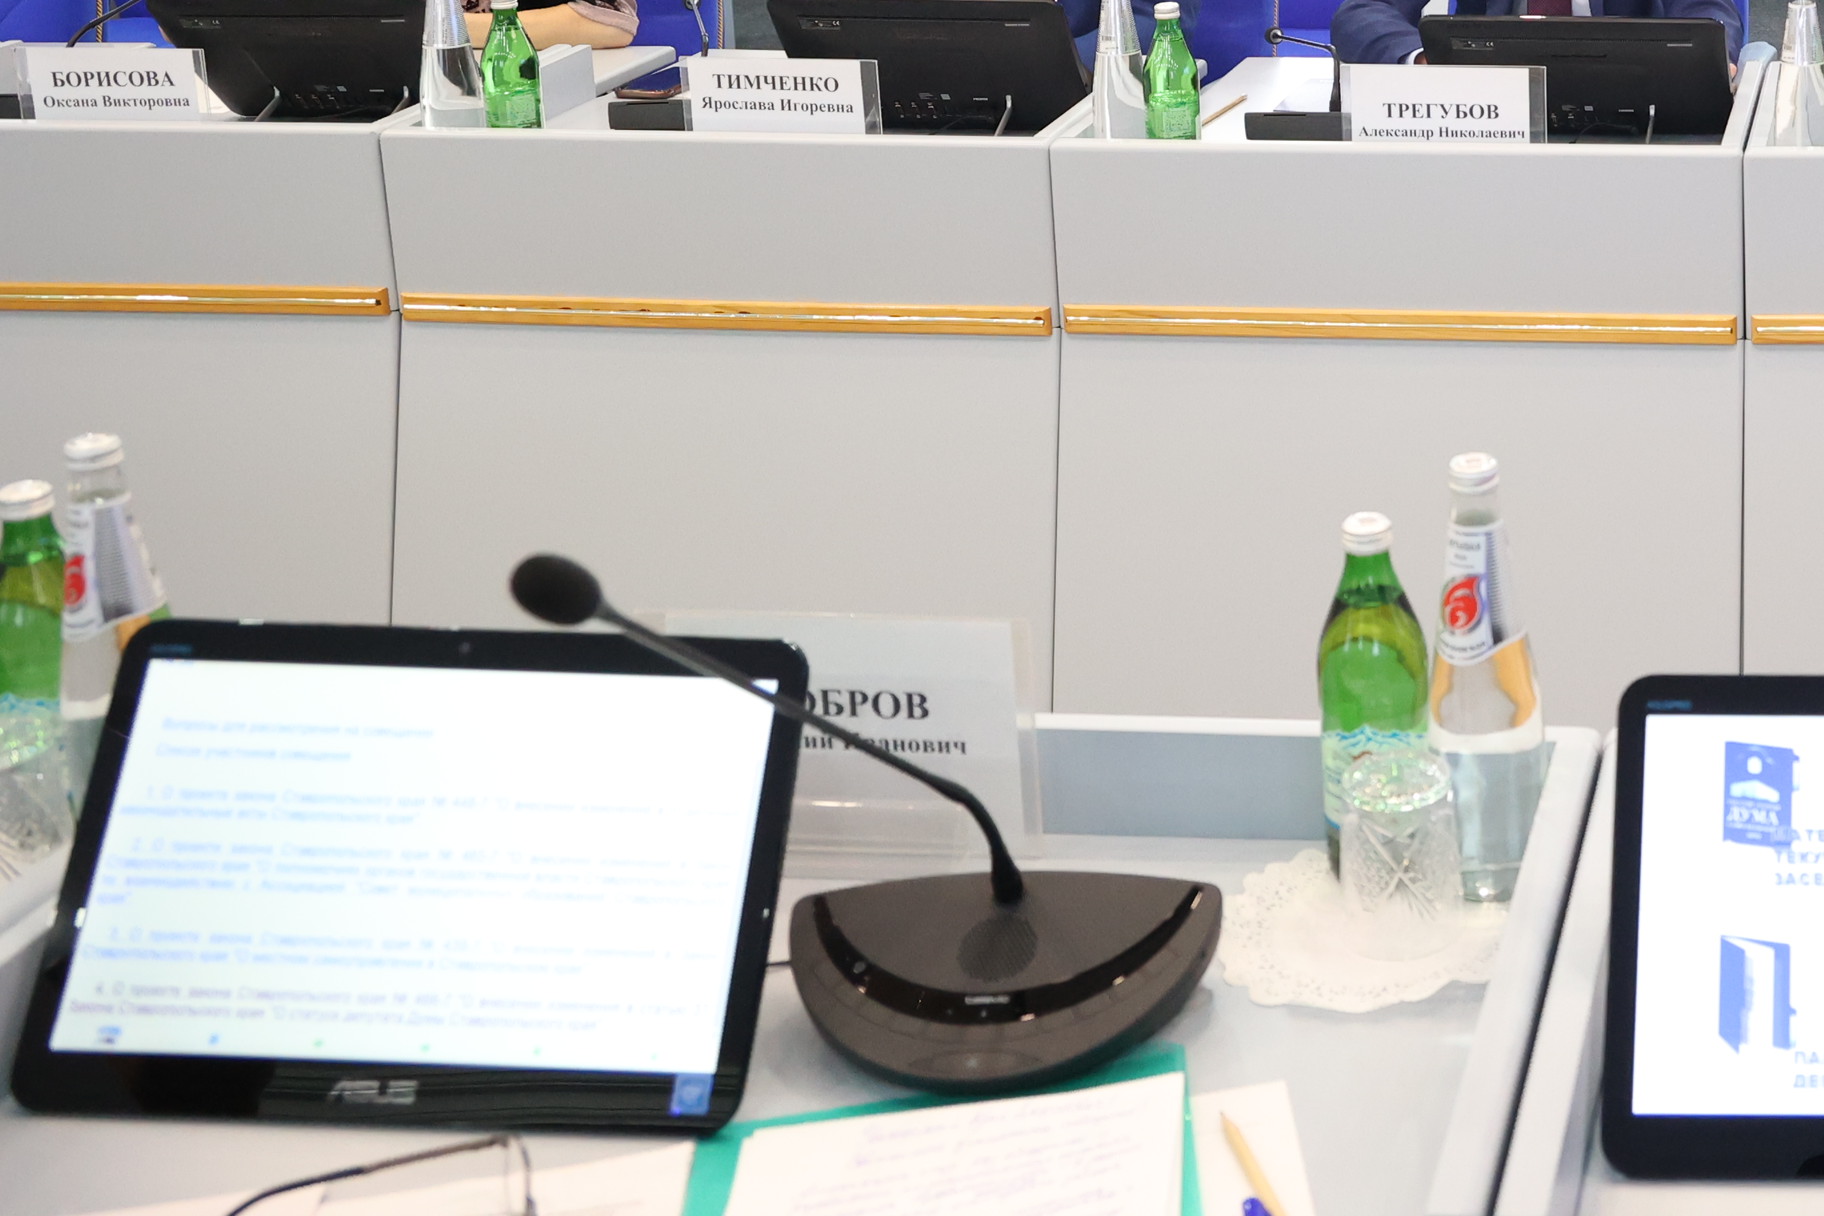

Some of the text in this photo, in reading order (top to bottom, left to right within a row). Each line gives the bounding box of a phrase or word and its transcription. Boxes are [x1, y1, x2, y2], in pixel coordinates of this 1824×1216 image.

[51, 71, 175, 88] БОРИСОВА
[712, 73, 839, 92] ТИМЧЕНКО
[43, 95, 190, 110] Оксана Викторовна
[702, 96, 854, 115] Ярослава Игоревна
[1382, 102, 1500, 120] ТРЕГУБОВ
[1359, 126, 1526, 140] Александр Николаевич
